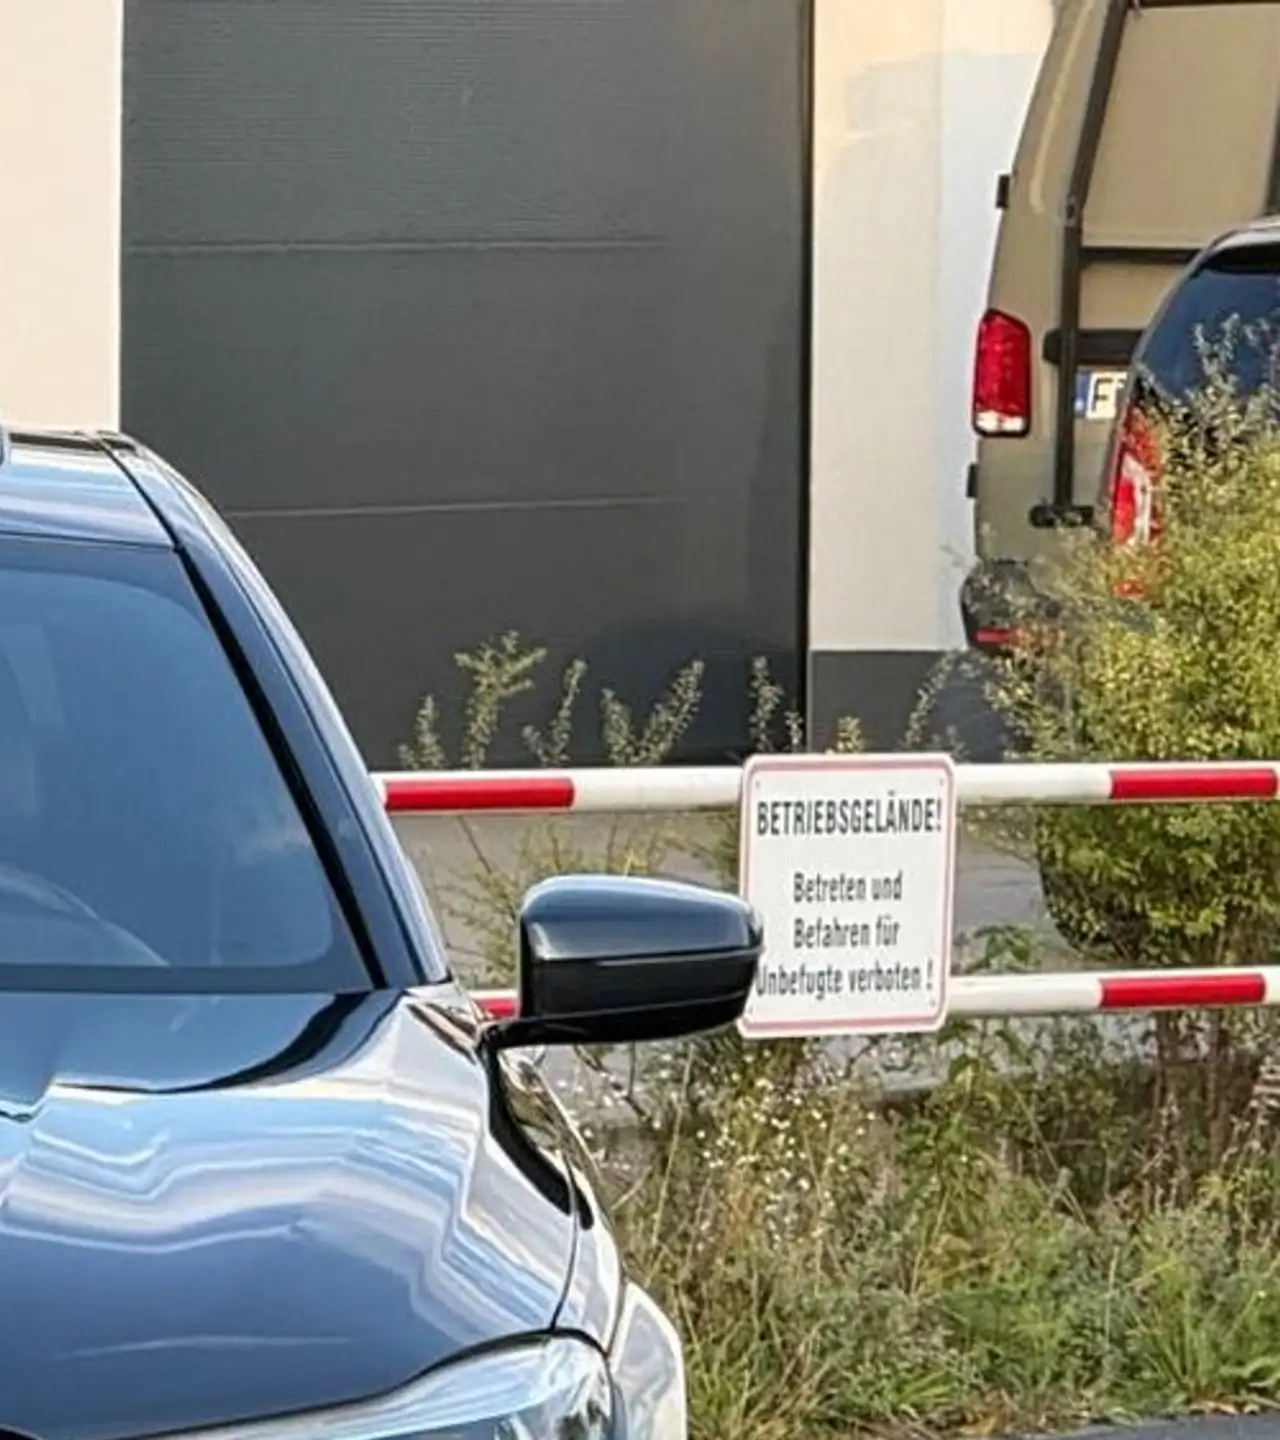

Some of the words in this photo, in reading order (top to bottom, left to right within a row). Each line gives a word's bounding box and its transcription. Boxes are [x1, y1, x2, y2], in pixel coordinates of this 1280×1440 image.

[756, 790, 943, 837] BETRIEBSGELÄNDE!
[793, 872, 867, 903] Betreten
[871, 869, 903, 901] und
[793, 916, 871, 949] Befahren
[875, 913, 901, 947] für
[755, 962, 844, 1000] Unbefugte
[848, 960, 922, 993] verboten
